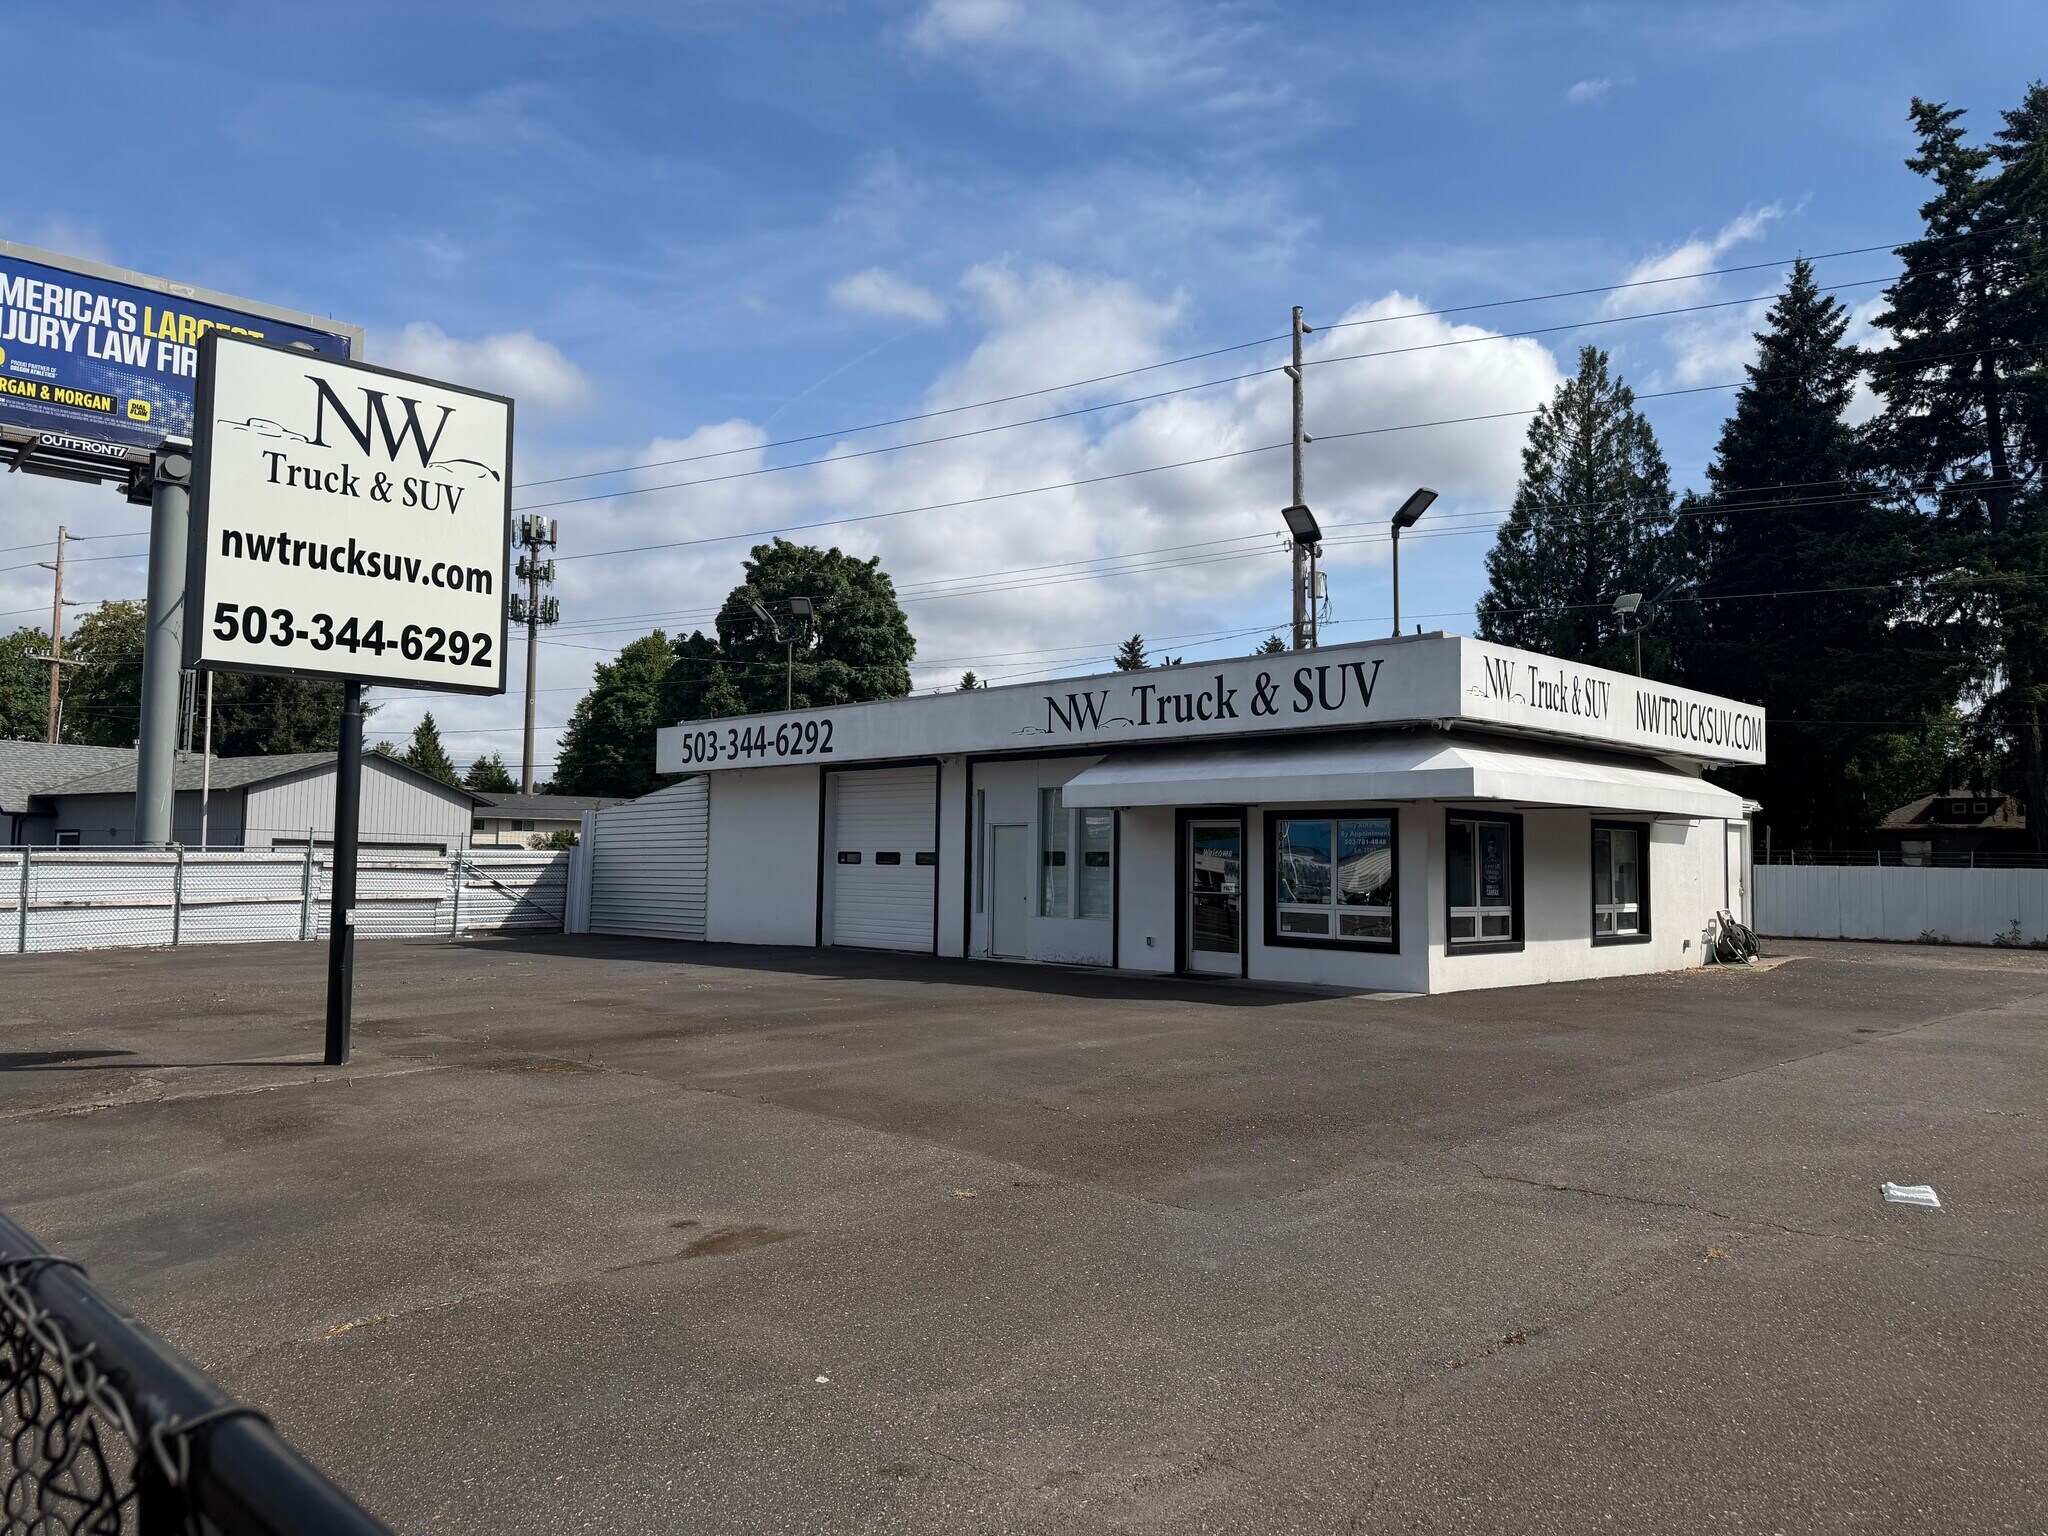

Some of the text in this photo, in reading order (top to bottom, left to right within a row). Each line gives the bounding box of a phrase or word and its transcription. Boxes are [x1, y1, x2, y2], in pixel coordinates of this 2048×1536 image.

[0, 307, 81, 352] JURY
[87, 326, 151, 368] LAW
[144, 306, 264, 346] LARG
[10, 359, 28, 368] PROUD
[28, 362, 50, 371] PARTNER
[10, 365, 30, 374] OREGON
[40, 385, 50, 400] &
[54, 387, 112, 412] MORGAN
[131, 403, 146, 411] DIAL
[304, 375, 457, 469] NW
[262, 450, 465, 515] Truck & SUV
[221, 528, 493, 595] nwtrucksuv.com
[212, 602, 493, 668] 503-344-6292
[1043, 659, 1385, 734] NW Truck & SUV
[1482, 655, 1611, 720] NW Truck & SUV
[681, 719, 834, 764] 503-344-6292
[1636, 690, 1763, 752] NWTRUCKSUV.COM
[1203, 848, 1233, 858] Welcome
[1340, 830, 1391, 838] By Appointment
